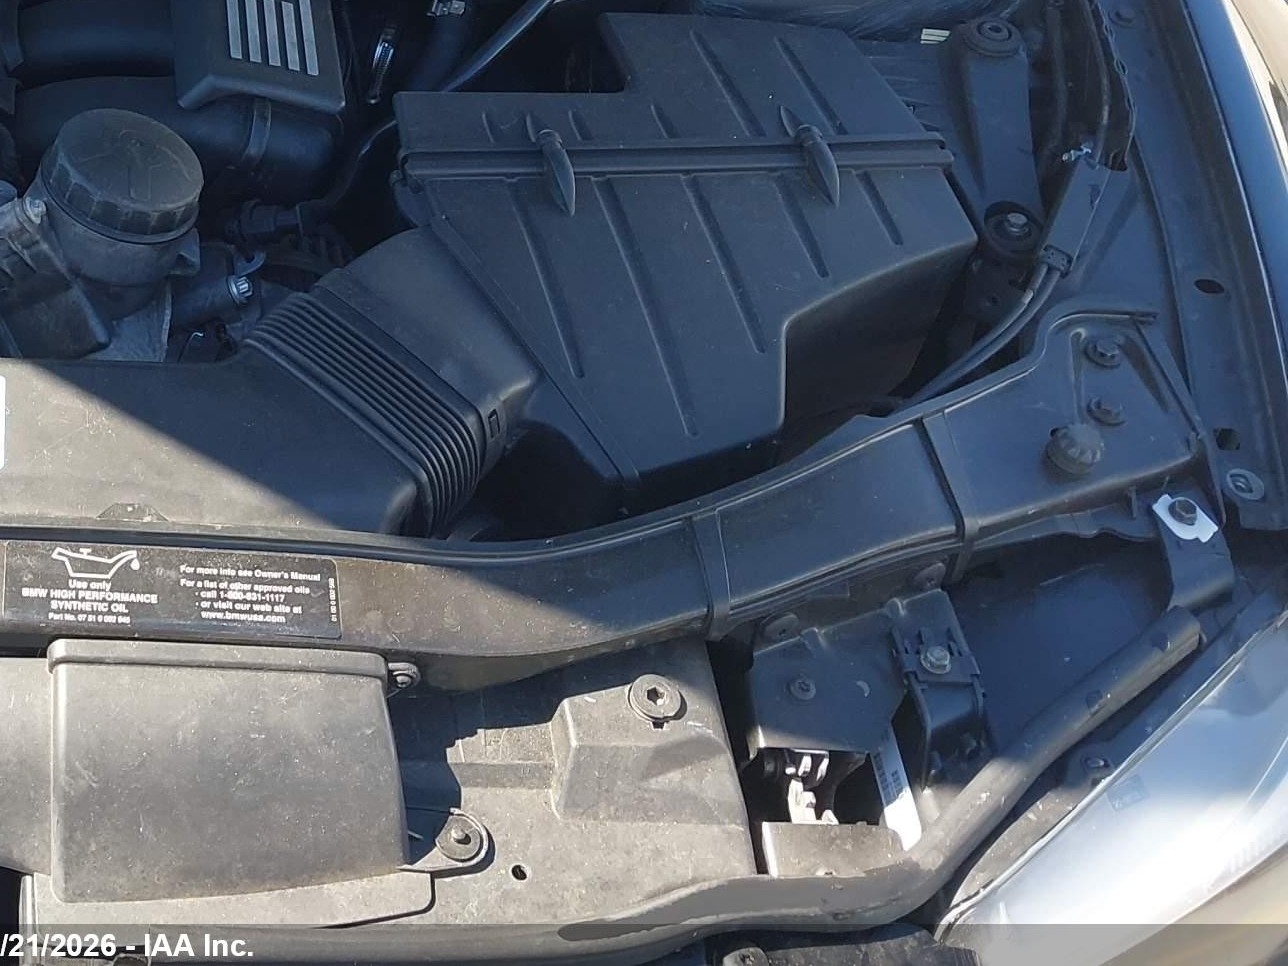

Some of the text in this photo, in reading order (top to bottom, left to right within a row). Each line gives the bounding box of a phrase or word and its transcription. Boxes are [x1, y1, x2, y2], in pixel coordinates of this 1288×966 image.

[179, 564, 321, 581] For more info see Owner's Manual
[68, 579, 112, 592] Use only
[180, 578, 195, 587] For
[203, 580, 217, 588] list
[218, 581, 228, 589] of
[229, 581, 252, 591] other
[253, 584, 293, 594] approved
[294, 585, 310, 594] oils
[22, 587, 158, 604] BMW HIGH PERFORMANCE
[200, 590, 217, 599] call
[50, 600, 129, 613] SYNTHETIC OIL
[213, 600, 233, 609] visit
[234, 602, 251, 610] our
[252, 603, 272, 612] web
[200, 610, 286, 623] www.bmwusa.com
